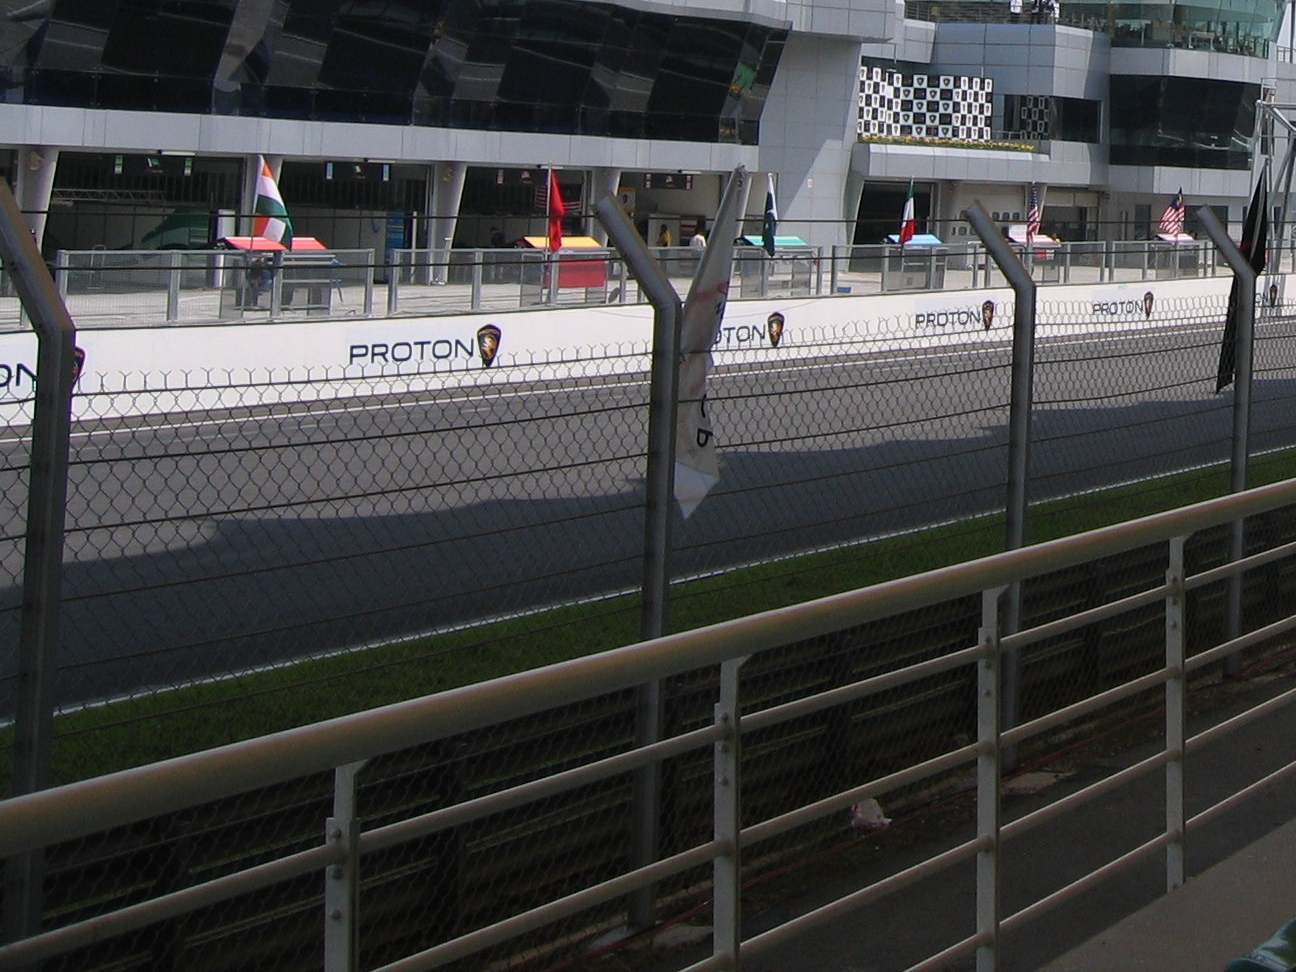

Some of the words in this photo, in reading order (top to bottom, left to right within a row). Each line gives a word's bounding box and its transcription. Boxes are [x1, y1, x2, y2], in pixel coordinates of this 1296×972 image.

[1092, 299, 1144, 316] PROTON
[915, 310, 981, 330] PROTON
[350, 338, 474, 365] PROTON
